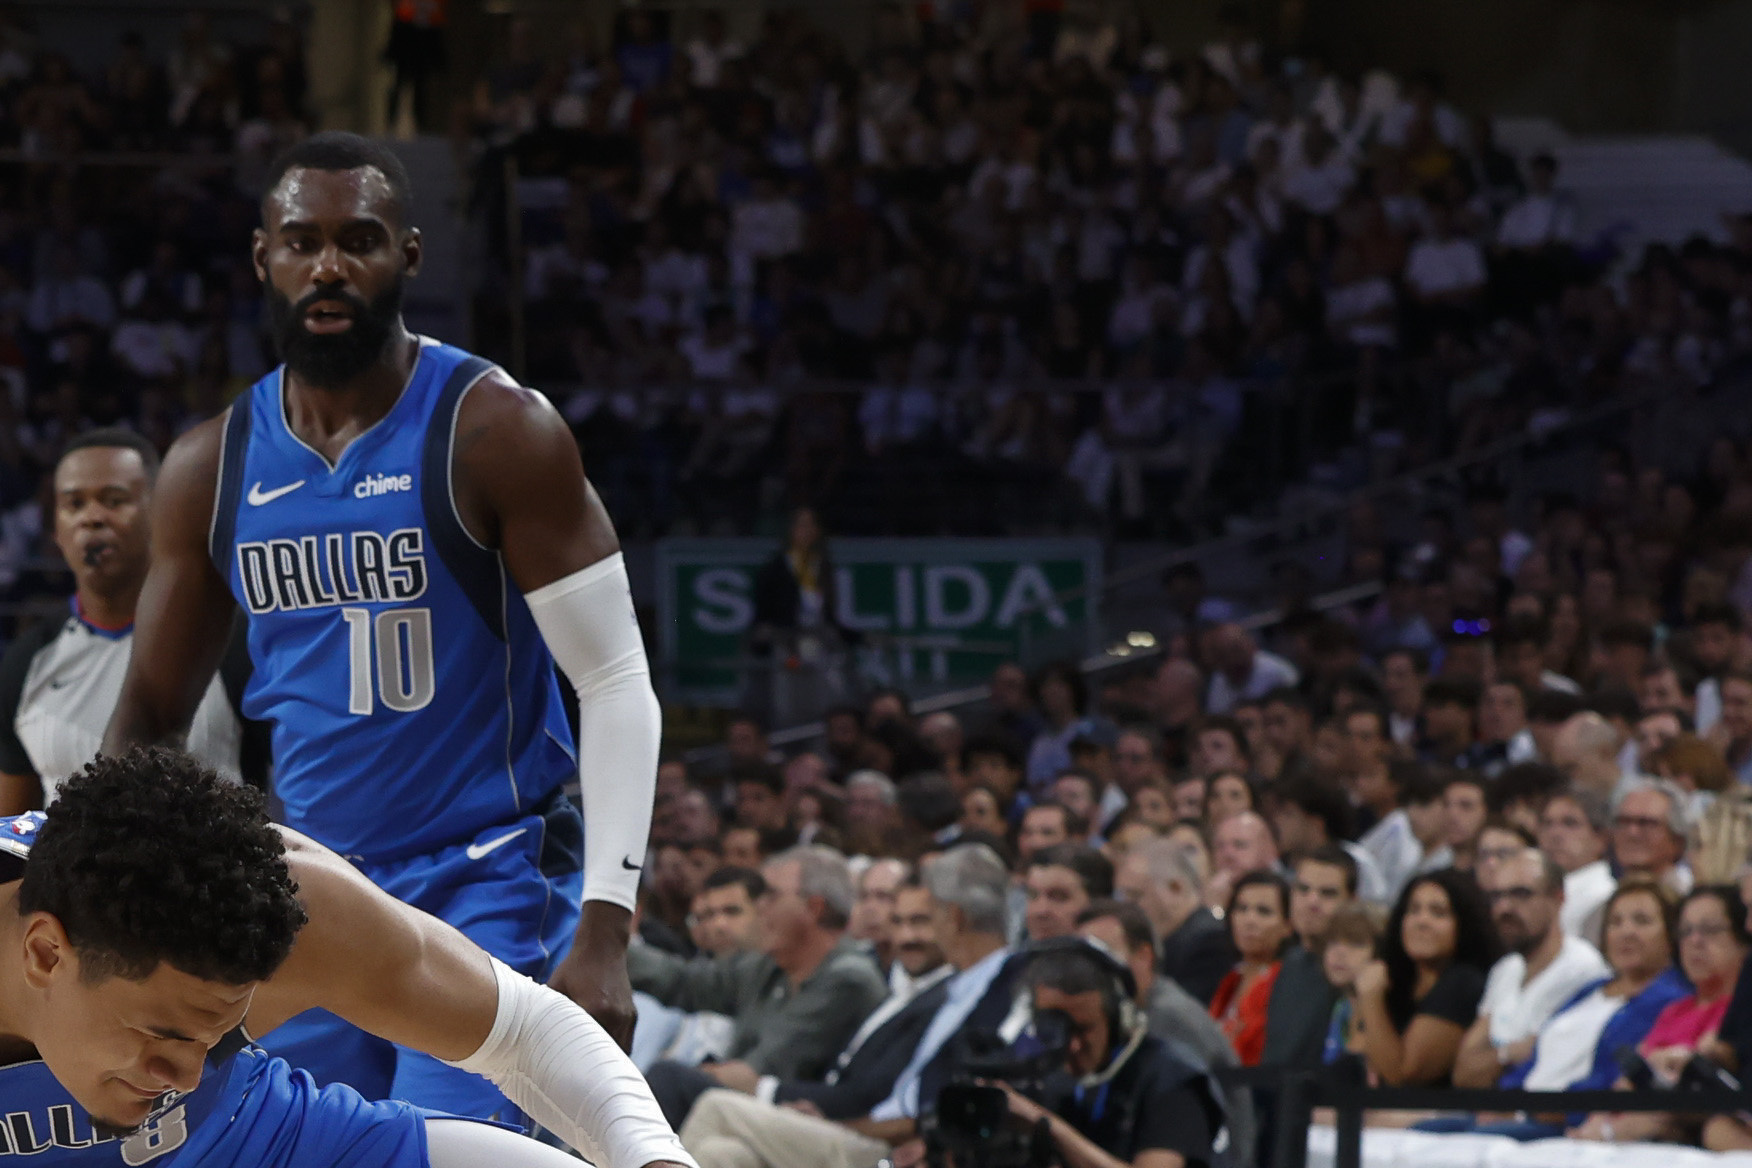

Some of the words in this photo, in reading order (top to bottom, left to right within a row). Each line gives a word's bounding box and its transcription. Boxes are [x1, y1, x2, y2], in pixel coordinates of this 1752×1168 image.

[354, 473, 412, 499] chime
[237, 527, 428, 614] DALLAS
[692, 565, 1069, 635] SLIDA
[342, 607, 436, 716] 10
